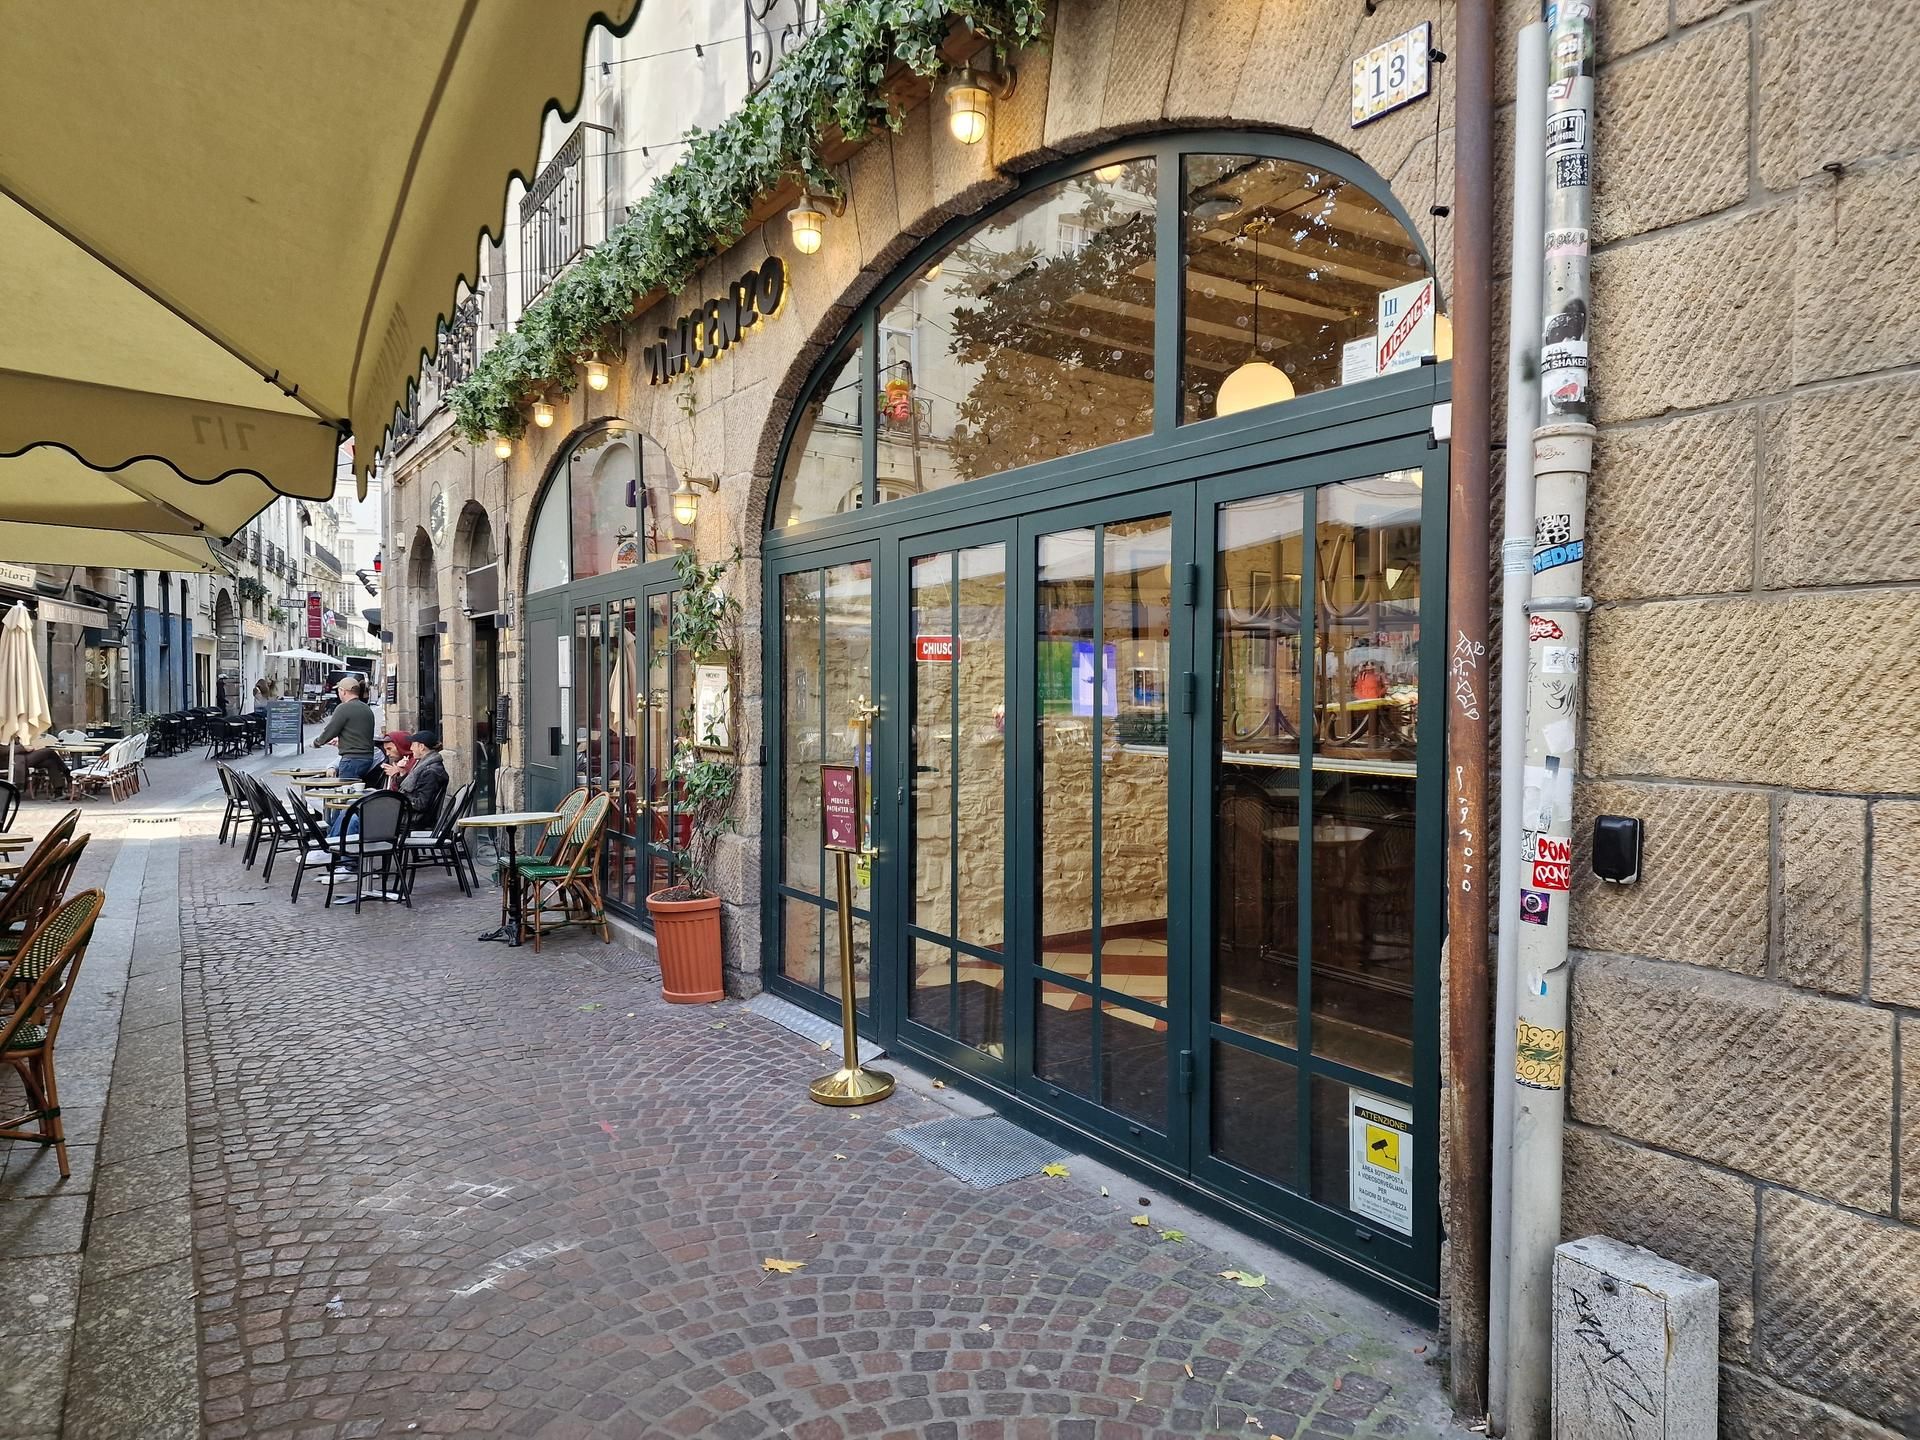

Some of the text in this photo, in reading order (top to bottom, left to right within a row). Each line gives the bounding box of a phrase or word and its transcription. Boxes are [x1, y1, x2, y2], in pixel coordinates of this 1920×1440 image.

[1371, 54, 1405, 98] 13
[1380, 285, 1431, 370] LICENCE
[1384, 320, 1394, 328] 44
[1555, 357, 1587, 370] SHAKER
[1520, 1024, 1564, 1053] 1984
[1516, 1055, 1561, 1086] 2024
[1361, 1109, 1407, 1131] ATTENZIONE!
[1362, 1164, 1373, 1173] AREA
[1378, 1187, 1387, 1195] PER
